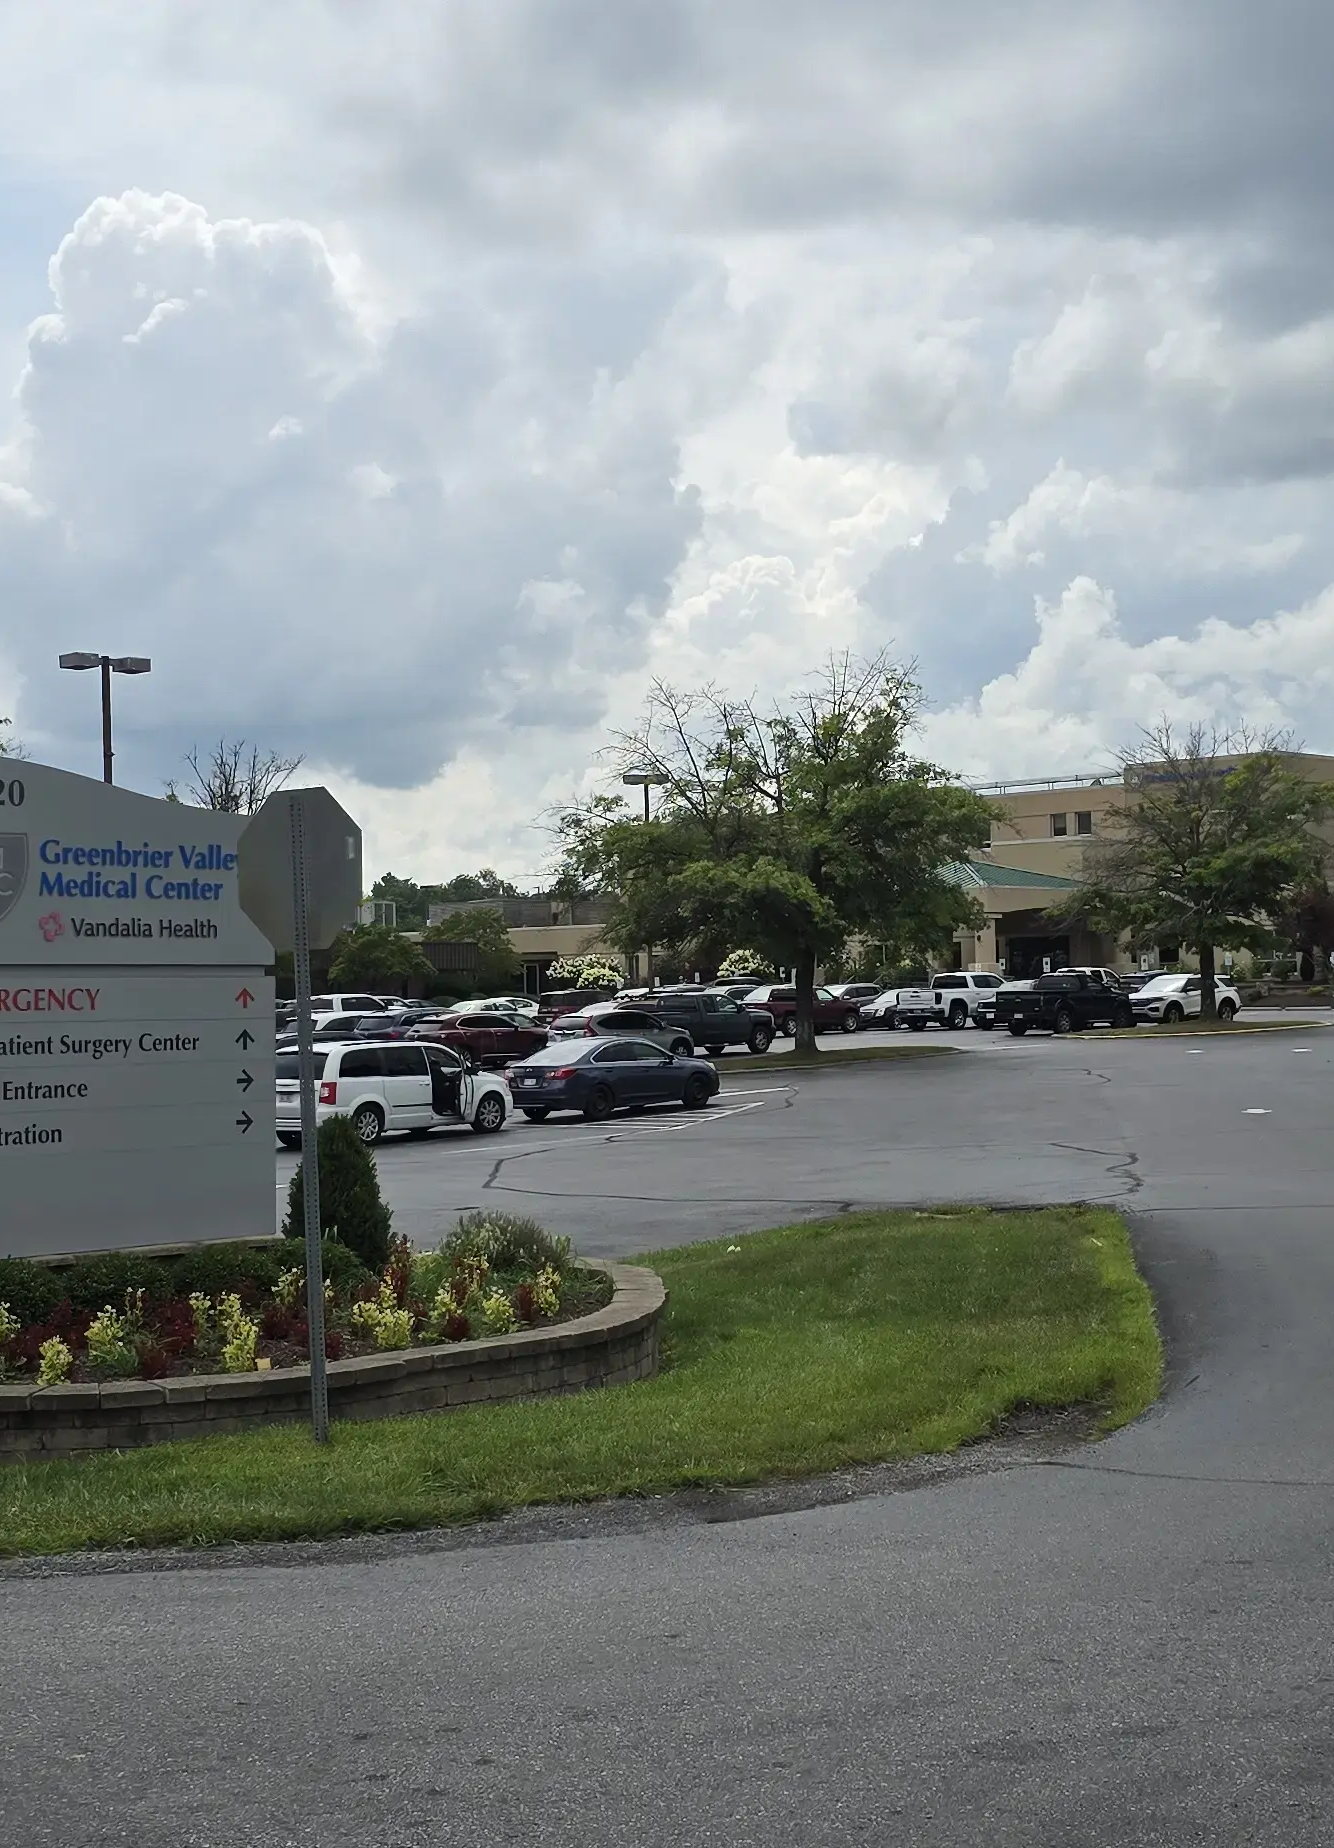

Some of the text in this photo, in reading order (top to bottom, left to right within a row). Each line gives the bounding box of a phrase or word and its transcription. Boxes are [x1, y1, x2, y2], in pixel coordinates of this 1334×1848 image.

[40, 839, 239, 871] Greenbrier Valle
[39, 871, 224, 901] Medical Center
[71, 917, 218, 940] Vandalia Health
[59, 1033, 132, 1060] Surgery
[138, 1032, 200, 1052] Center
[2, 1081, 88, 1102] Entrance
